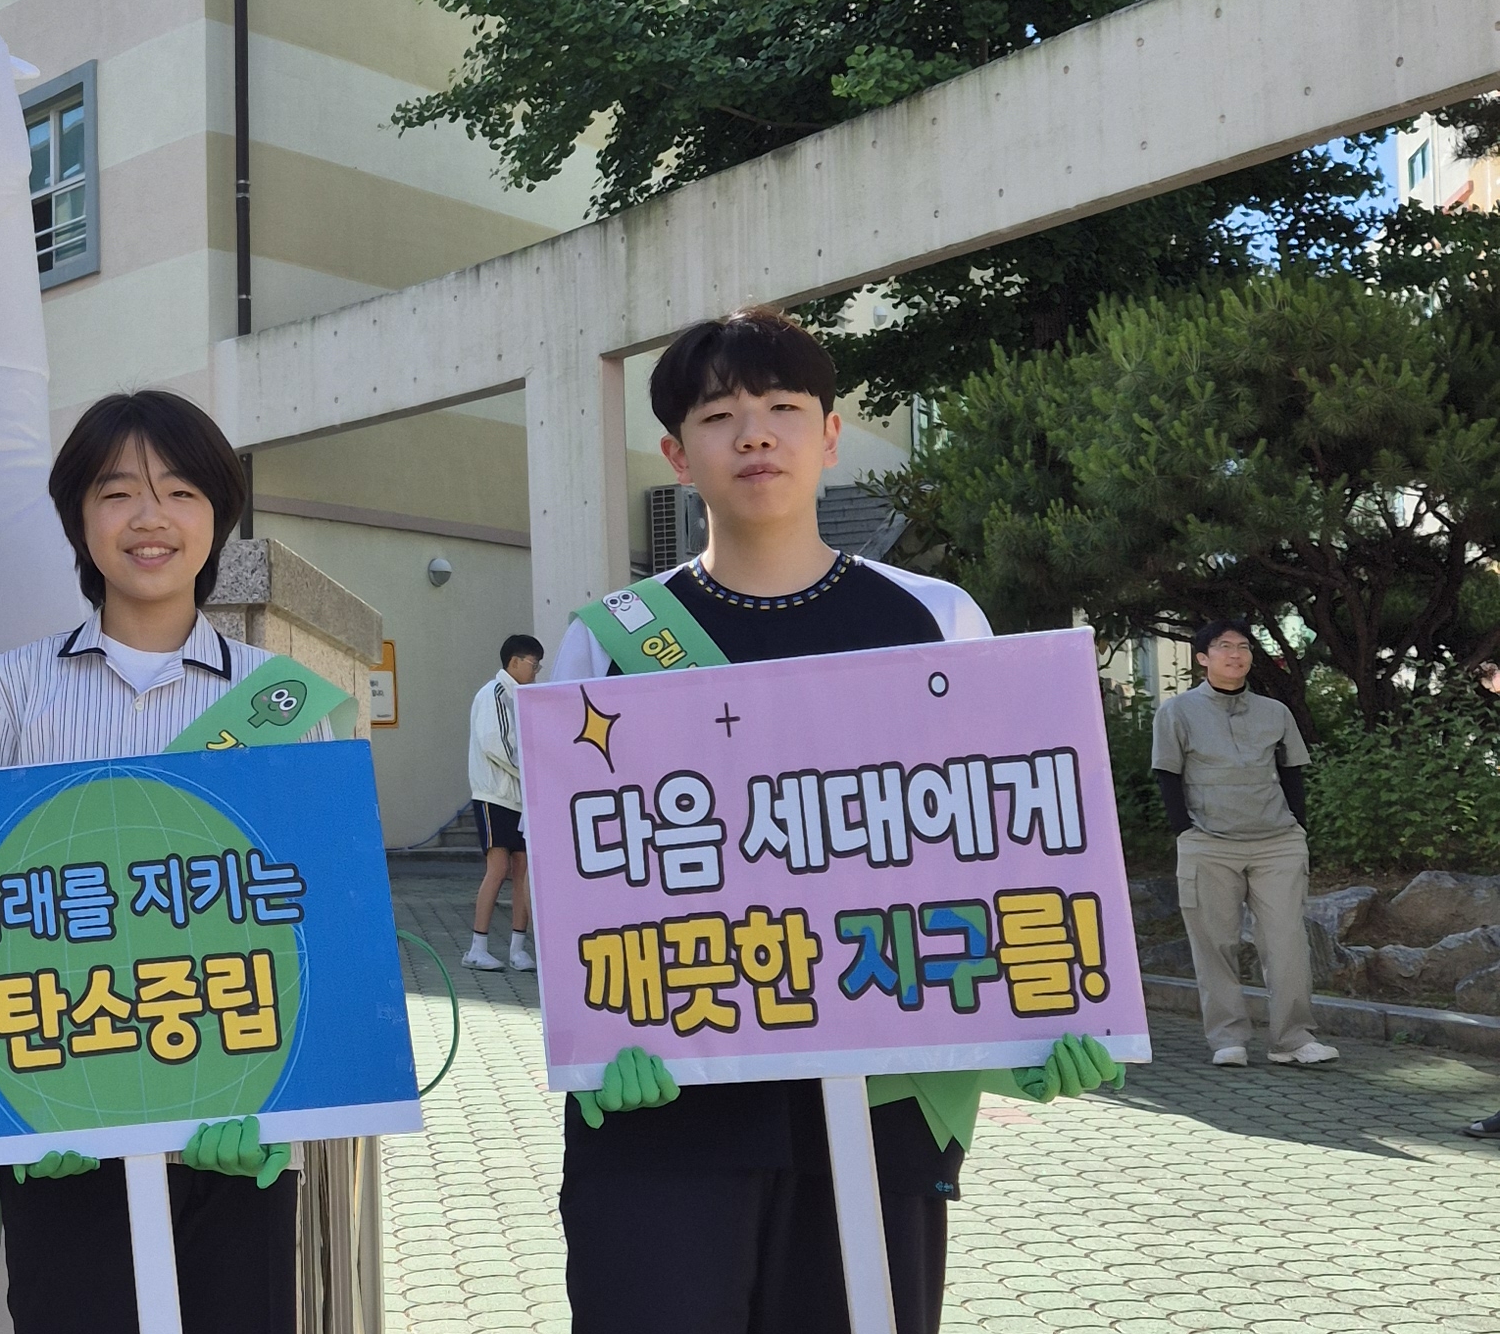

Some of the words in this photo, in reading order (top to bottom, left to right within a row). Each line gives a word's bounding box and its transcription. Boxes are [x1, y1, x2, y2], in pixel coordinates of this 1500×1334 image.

[129, 849, 309, 929] 지키는
[571, 769, 726, 896] 다음
[739, 746, 1087, 874] 세대에게
[578, 904, 822, 1037] 깨끗한
[836, 887, 1110, 1019] 지구를!
